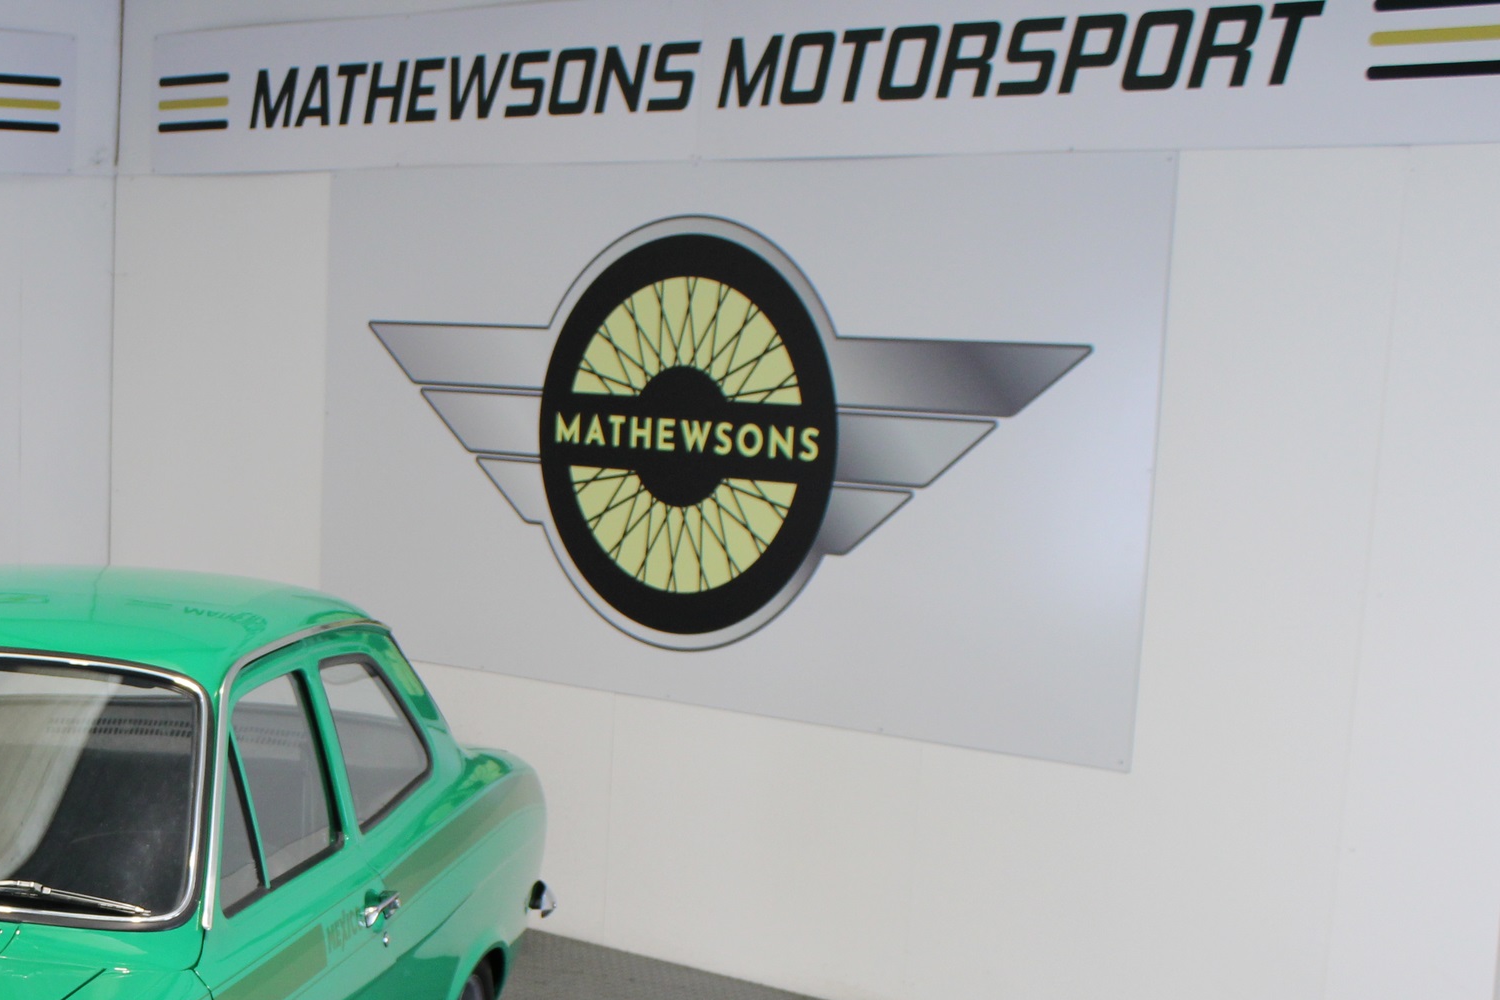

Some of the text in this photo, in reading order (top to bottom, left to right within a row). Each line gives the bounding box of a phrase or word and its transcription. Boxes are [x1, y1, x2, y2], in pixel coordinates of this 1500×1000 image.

[249, 0, 1327, 130] MATHEWSONS MOTORSPORT
[555, 411, 820, 462] MATHEWSONS
